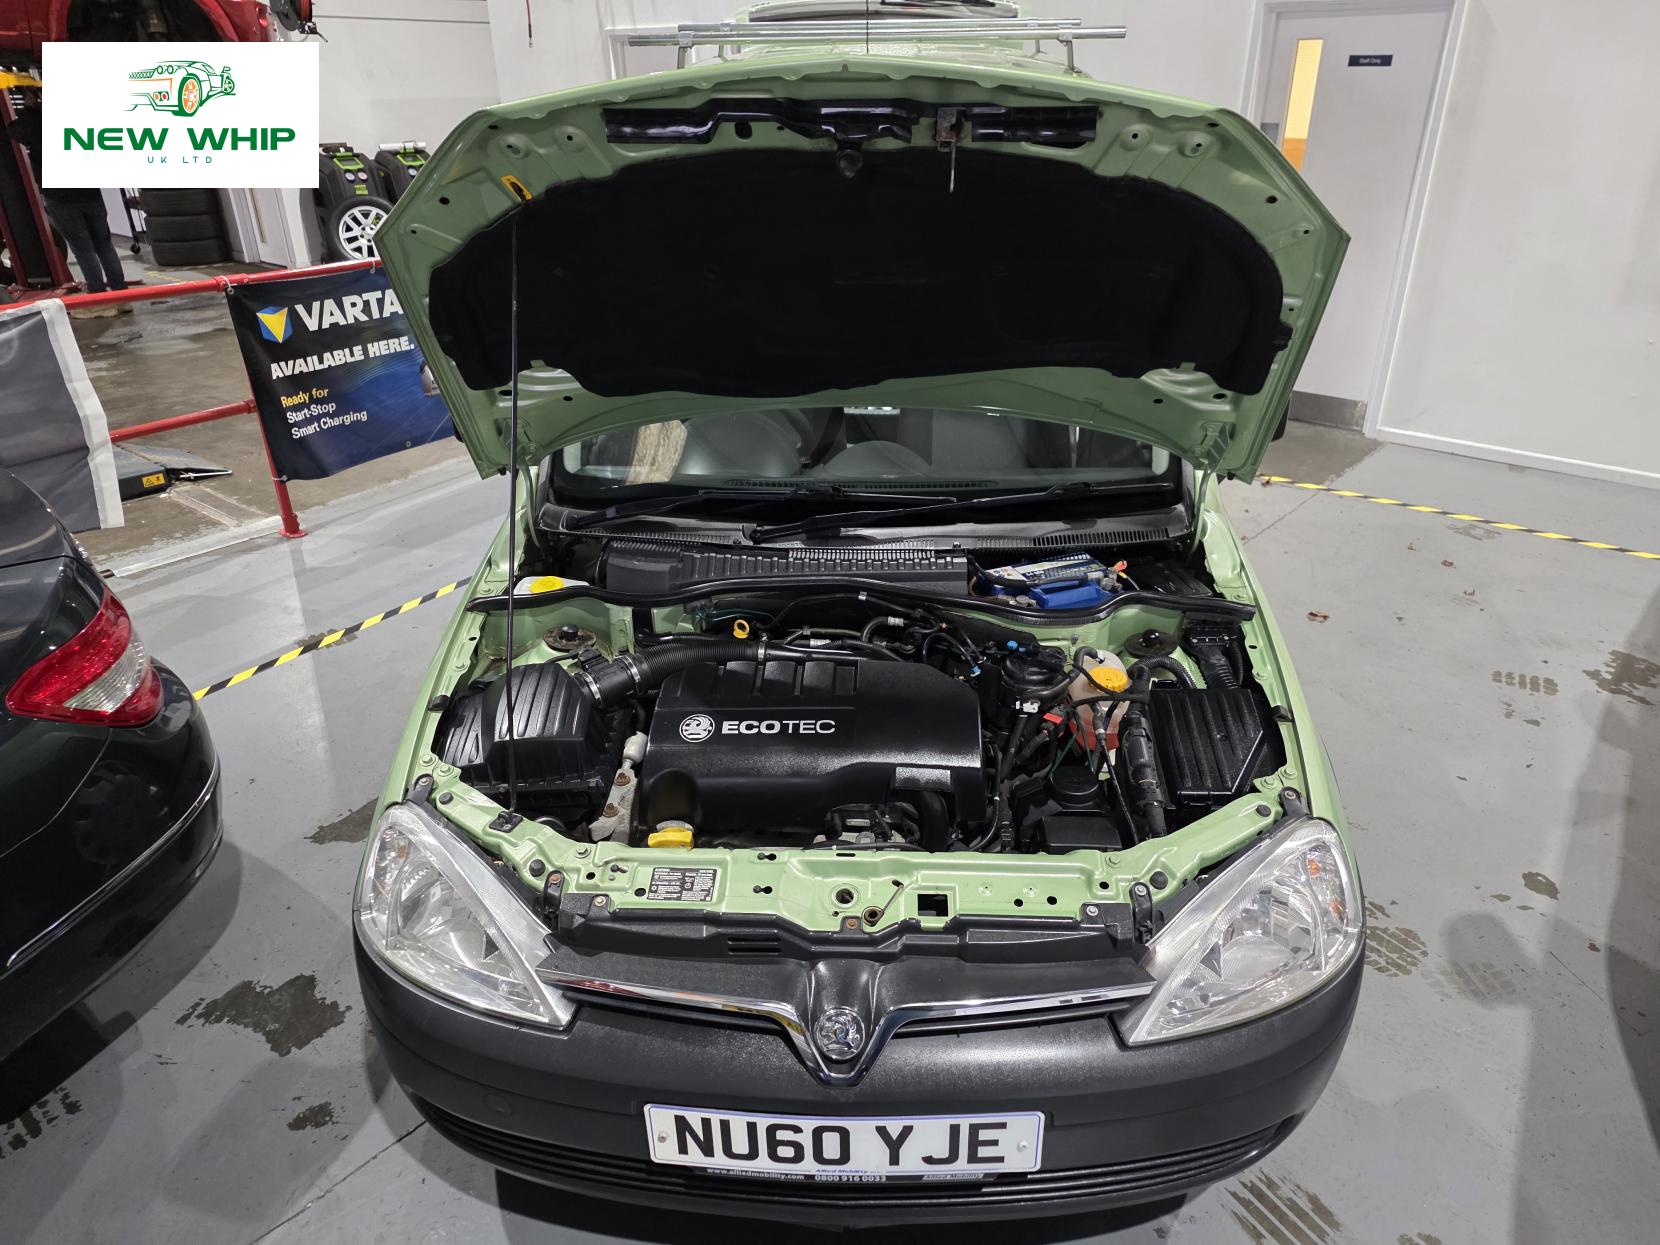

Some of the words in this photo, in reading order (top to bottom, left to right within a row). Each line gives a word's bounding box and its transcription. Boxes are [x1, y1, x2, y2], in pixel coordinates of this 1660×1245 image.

[294, 288, 404, 332] VARTA
[270, 345, 364, 379] AVAILABLE
[367, 336, 415, 358] HERE.
[280, 391, 309, 408] Ready
[312, 387, 329, 399] for
[286, 402, 337, 424] Start-Stop
[291, 421, 320, 439] Smart
[320, 410, 368, 429] Charging
[721, 719, 836, 735] ECOTEC
[673, 1114, 851, 1165] NU60
[874, 1121, 1008, 1167] YJE
[706, 1167, 805, 1181] www.alliedmobility.com
[815, 1174, 840, 1182] 0800
[862, 1175, 887, 1183] 0033
